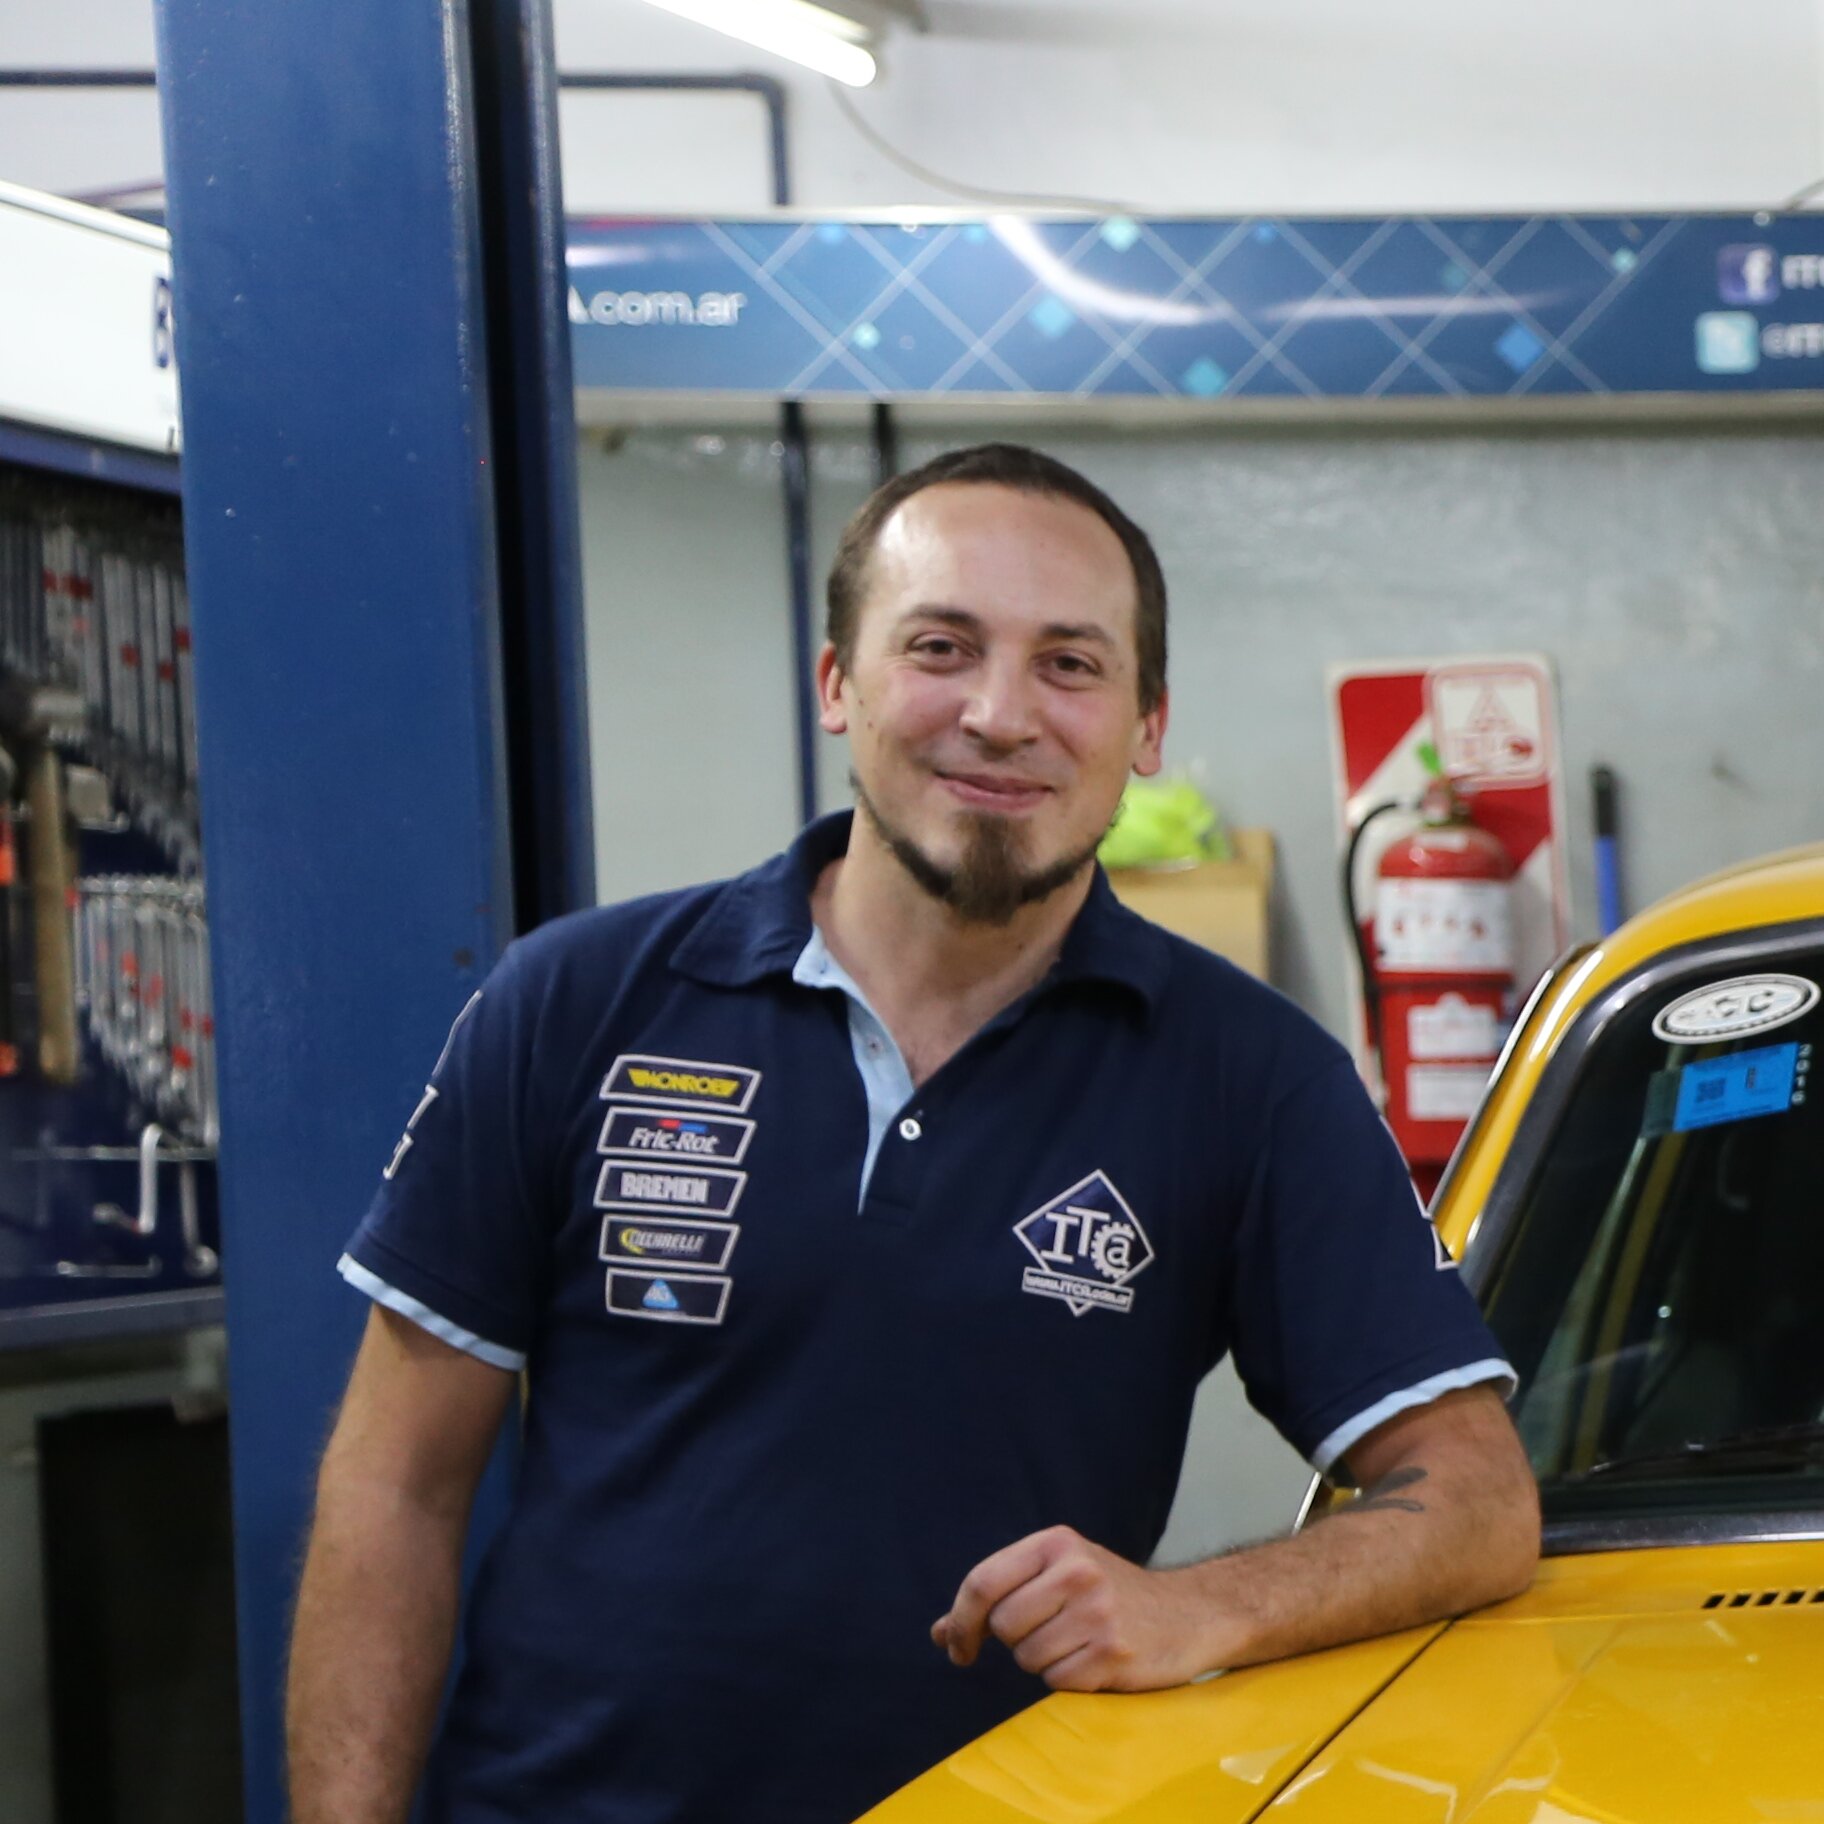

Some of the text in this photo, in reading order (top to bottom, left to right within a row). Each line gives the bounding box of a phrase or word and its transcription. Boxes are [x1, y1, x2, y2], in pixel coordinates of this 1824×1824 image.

[627, 1067, 740, 1099] MONROE
[628, 1126, 720, 1154] Fric-Rot
[620, 1172, 710, 1205] BREMEN
